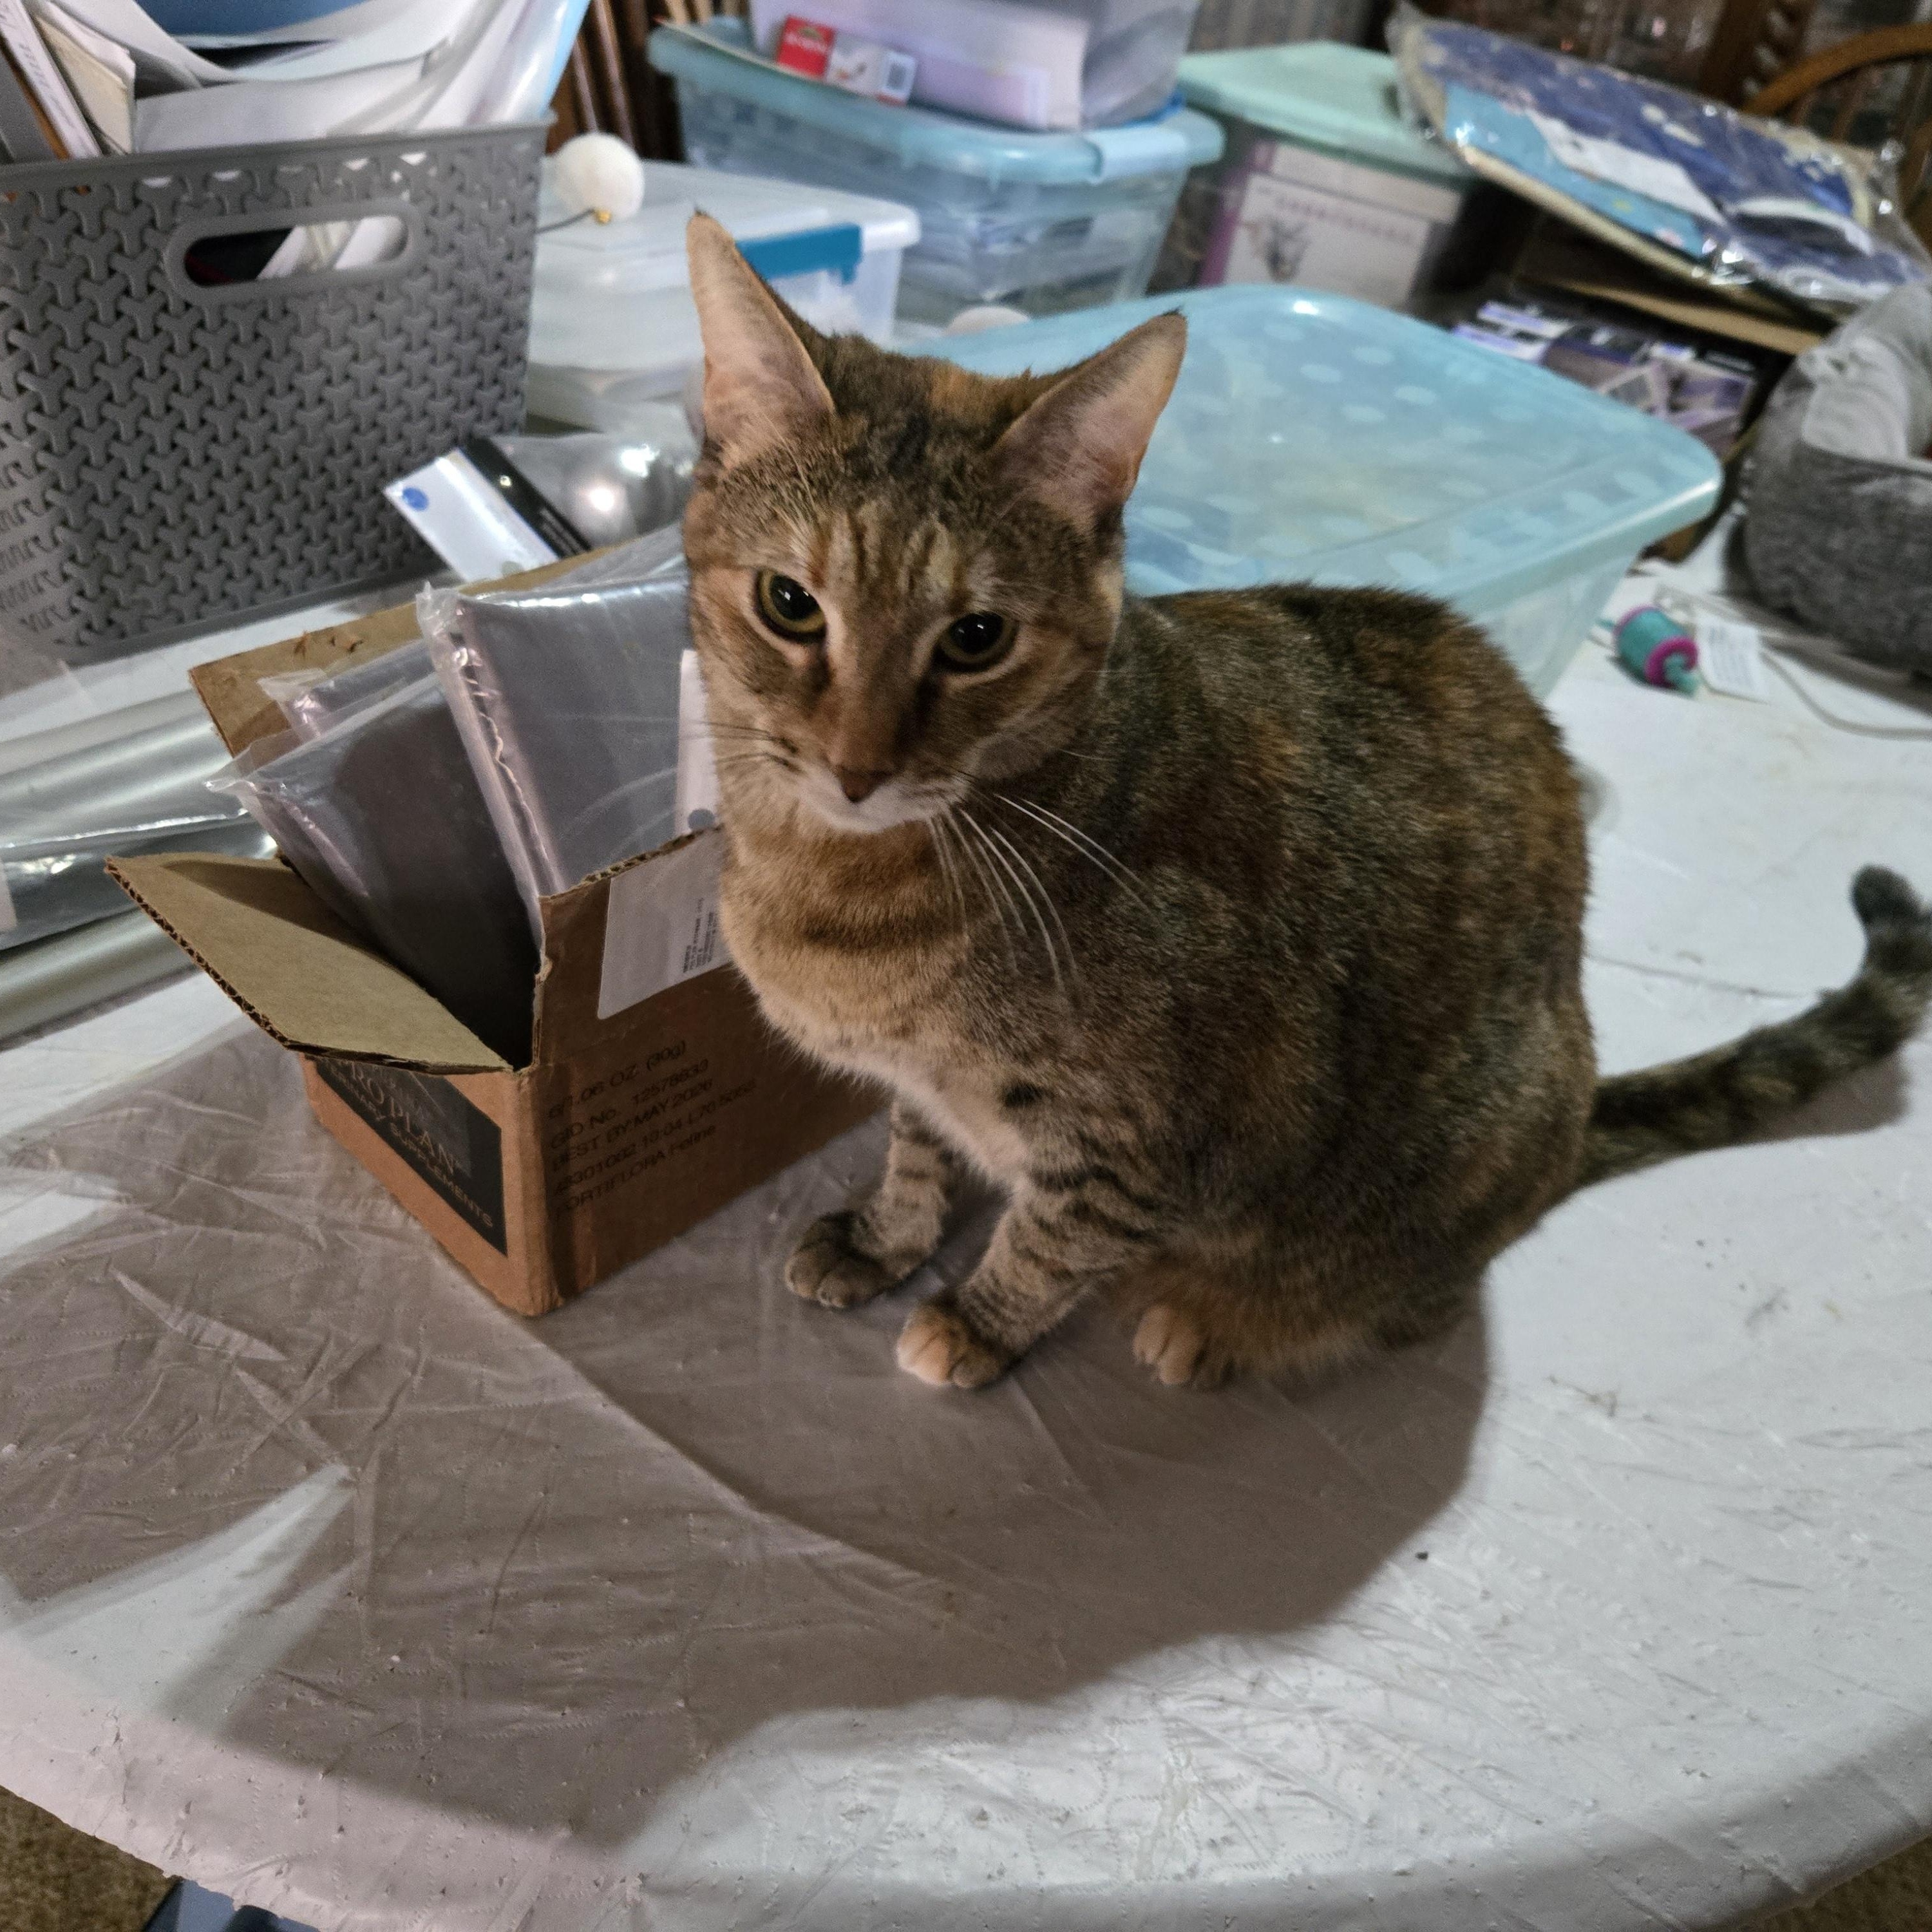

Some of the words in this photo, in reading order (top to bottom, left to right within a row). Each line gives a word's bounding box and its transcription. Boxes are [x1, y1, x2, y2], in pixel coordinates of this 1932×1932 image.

[609, 1064, 639, 1087] OZ
[388, 1096, 455, 1176] PLAN
[389, 1122, 493, 1227] SUPPLEMENTS
